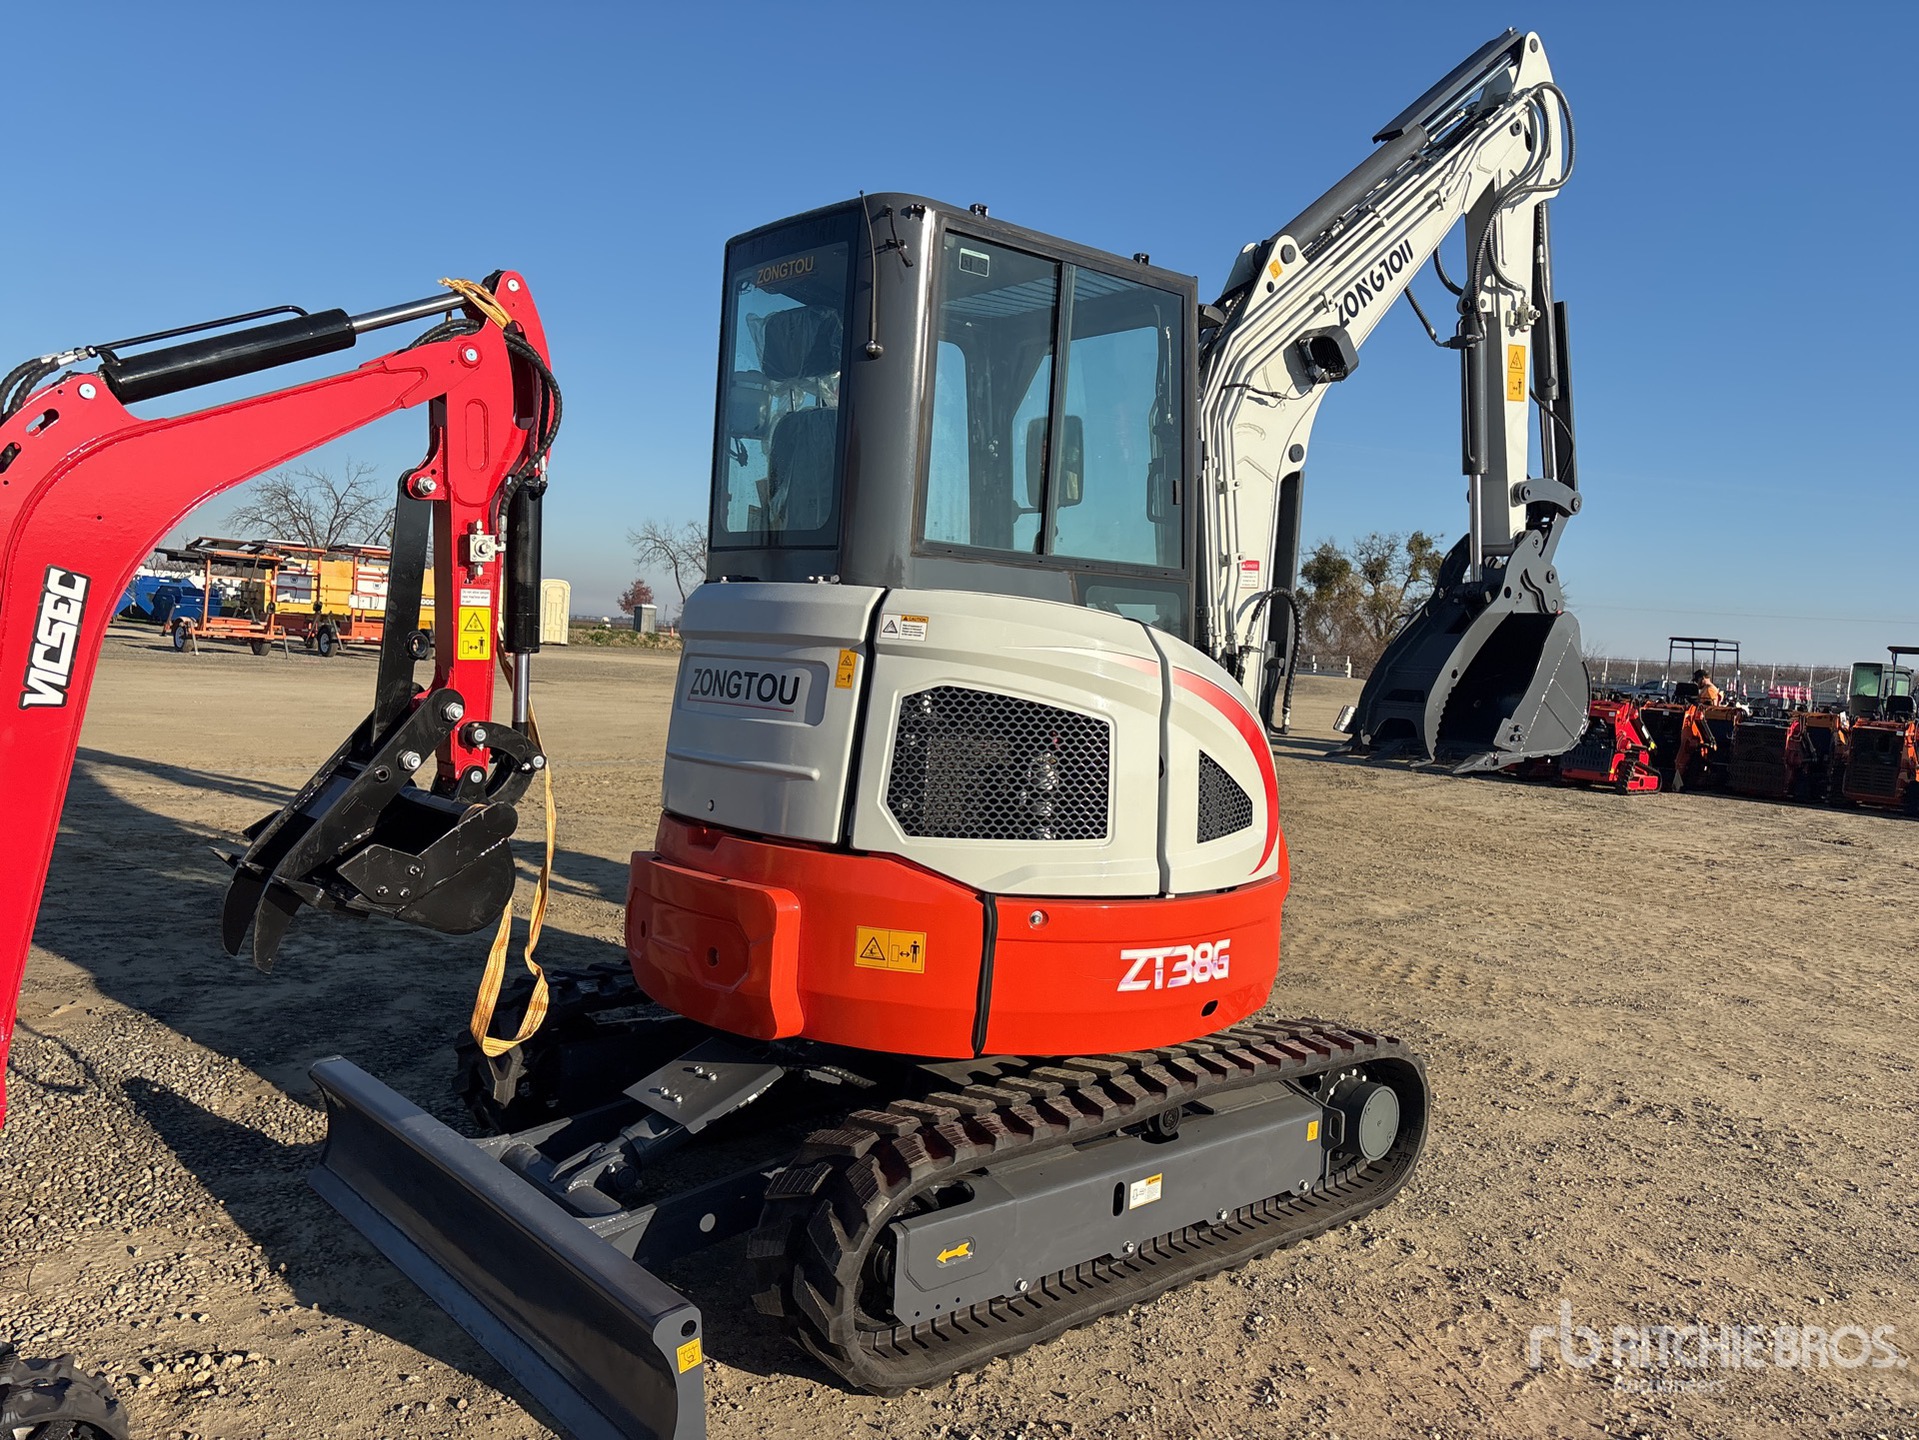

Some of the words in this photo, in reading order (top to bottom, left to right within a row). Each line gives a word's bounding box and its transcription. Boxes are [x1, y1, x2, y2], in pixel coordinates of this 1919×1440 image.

[757, 256, 814, 284] ZONGTOU
[22, 567, 88, 707] VICSEC
[690, 668, 800, 705] ZONGTOU
[1117, 938, 1231, 991] ZT38G
